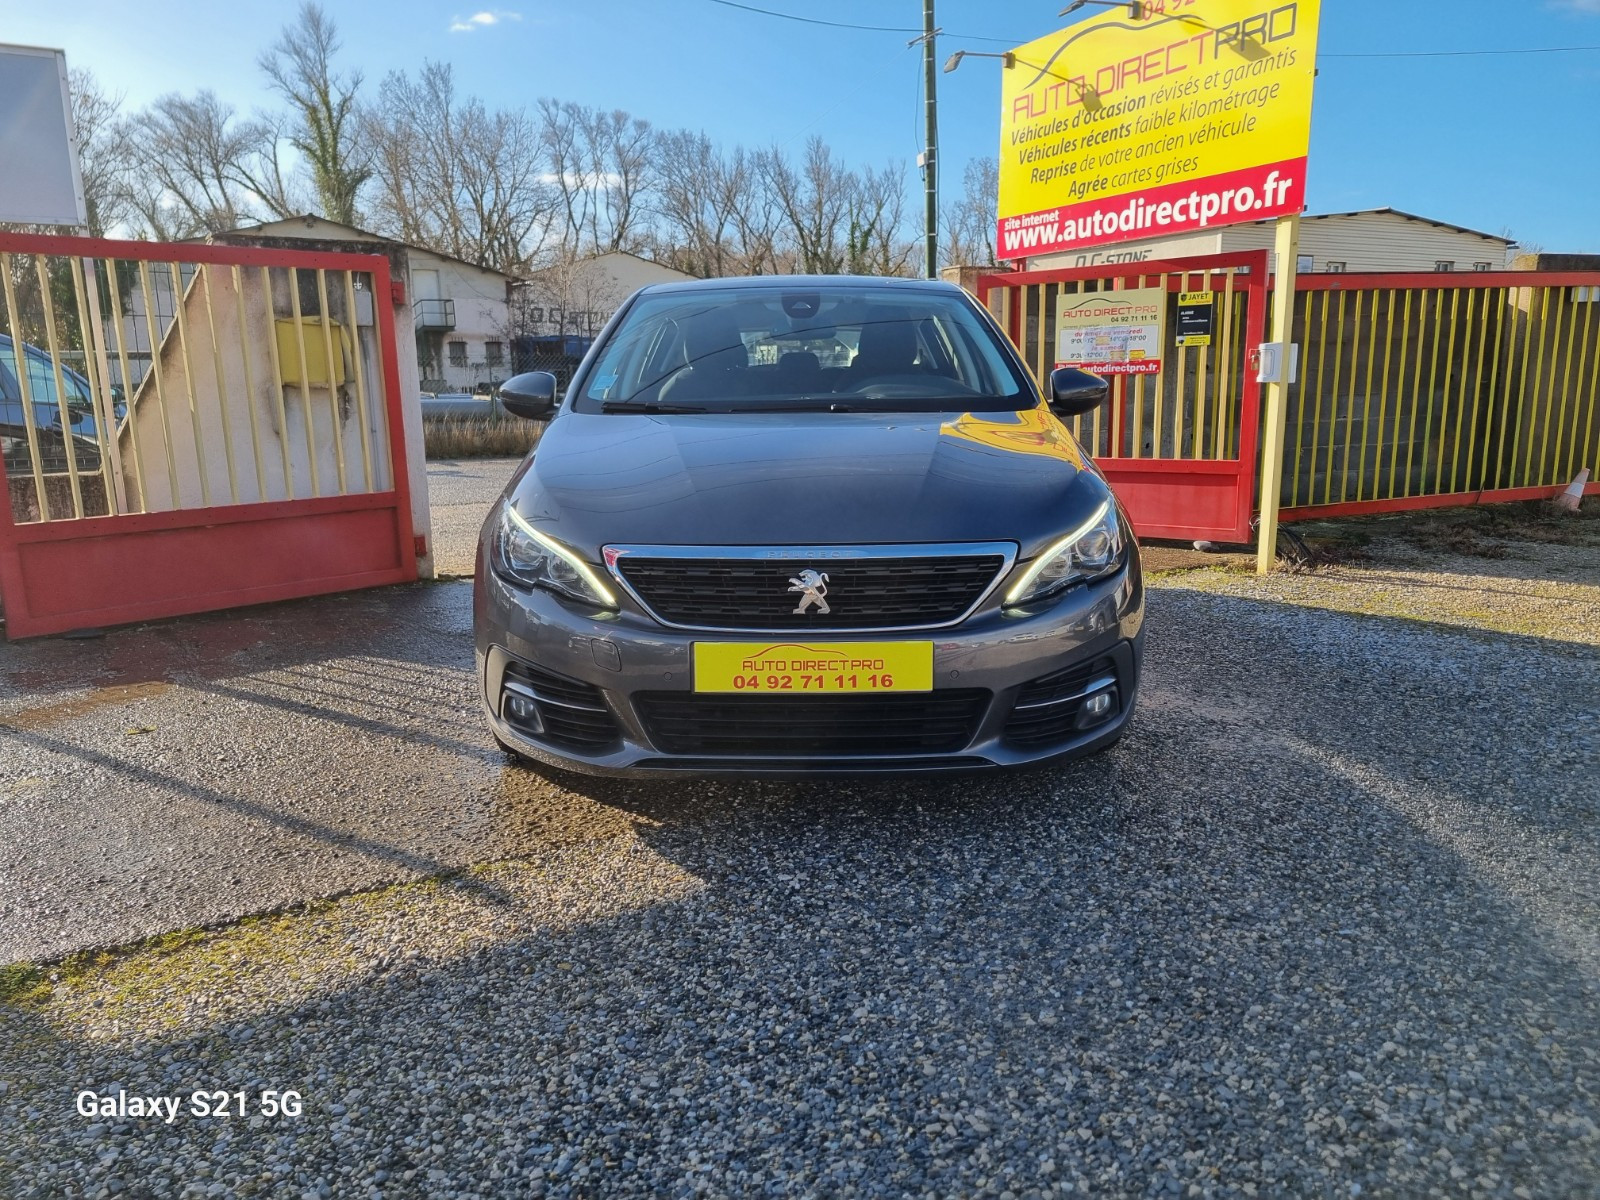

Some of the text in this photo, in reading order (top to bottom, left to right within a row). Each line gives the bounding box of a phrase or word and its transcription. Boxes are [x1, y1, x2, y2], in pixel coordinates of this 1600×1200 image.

[1011, 46, 1297, 146] Véhicules d'occasion révisés et garantis
[1013, 75, 1085, 124] AUTO
[1019, 82, 1280, 165] Véhicules récents faible kilométrage
[1031, 112, 1256, 184] Reprise de votre ancien véhicule
[1068, 155, 1199, 200] Agrée cartes grises
[1004, 170, 1293, 251] www.autodirectpro.fr
[1004, 209, 1059, 231] site internet
[1063, 309, 1092, 318] AUTO
[1188, 292, 1209, 301] JAYET
[733, 674, 893, 689] 04 92 71 11 16
[742, 660, 787, 671] AUTO
